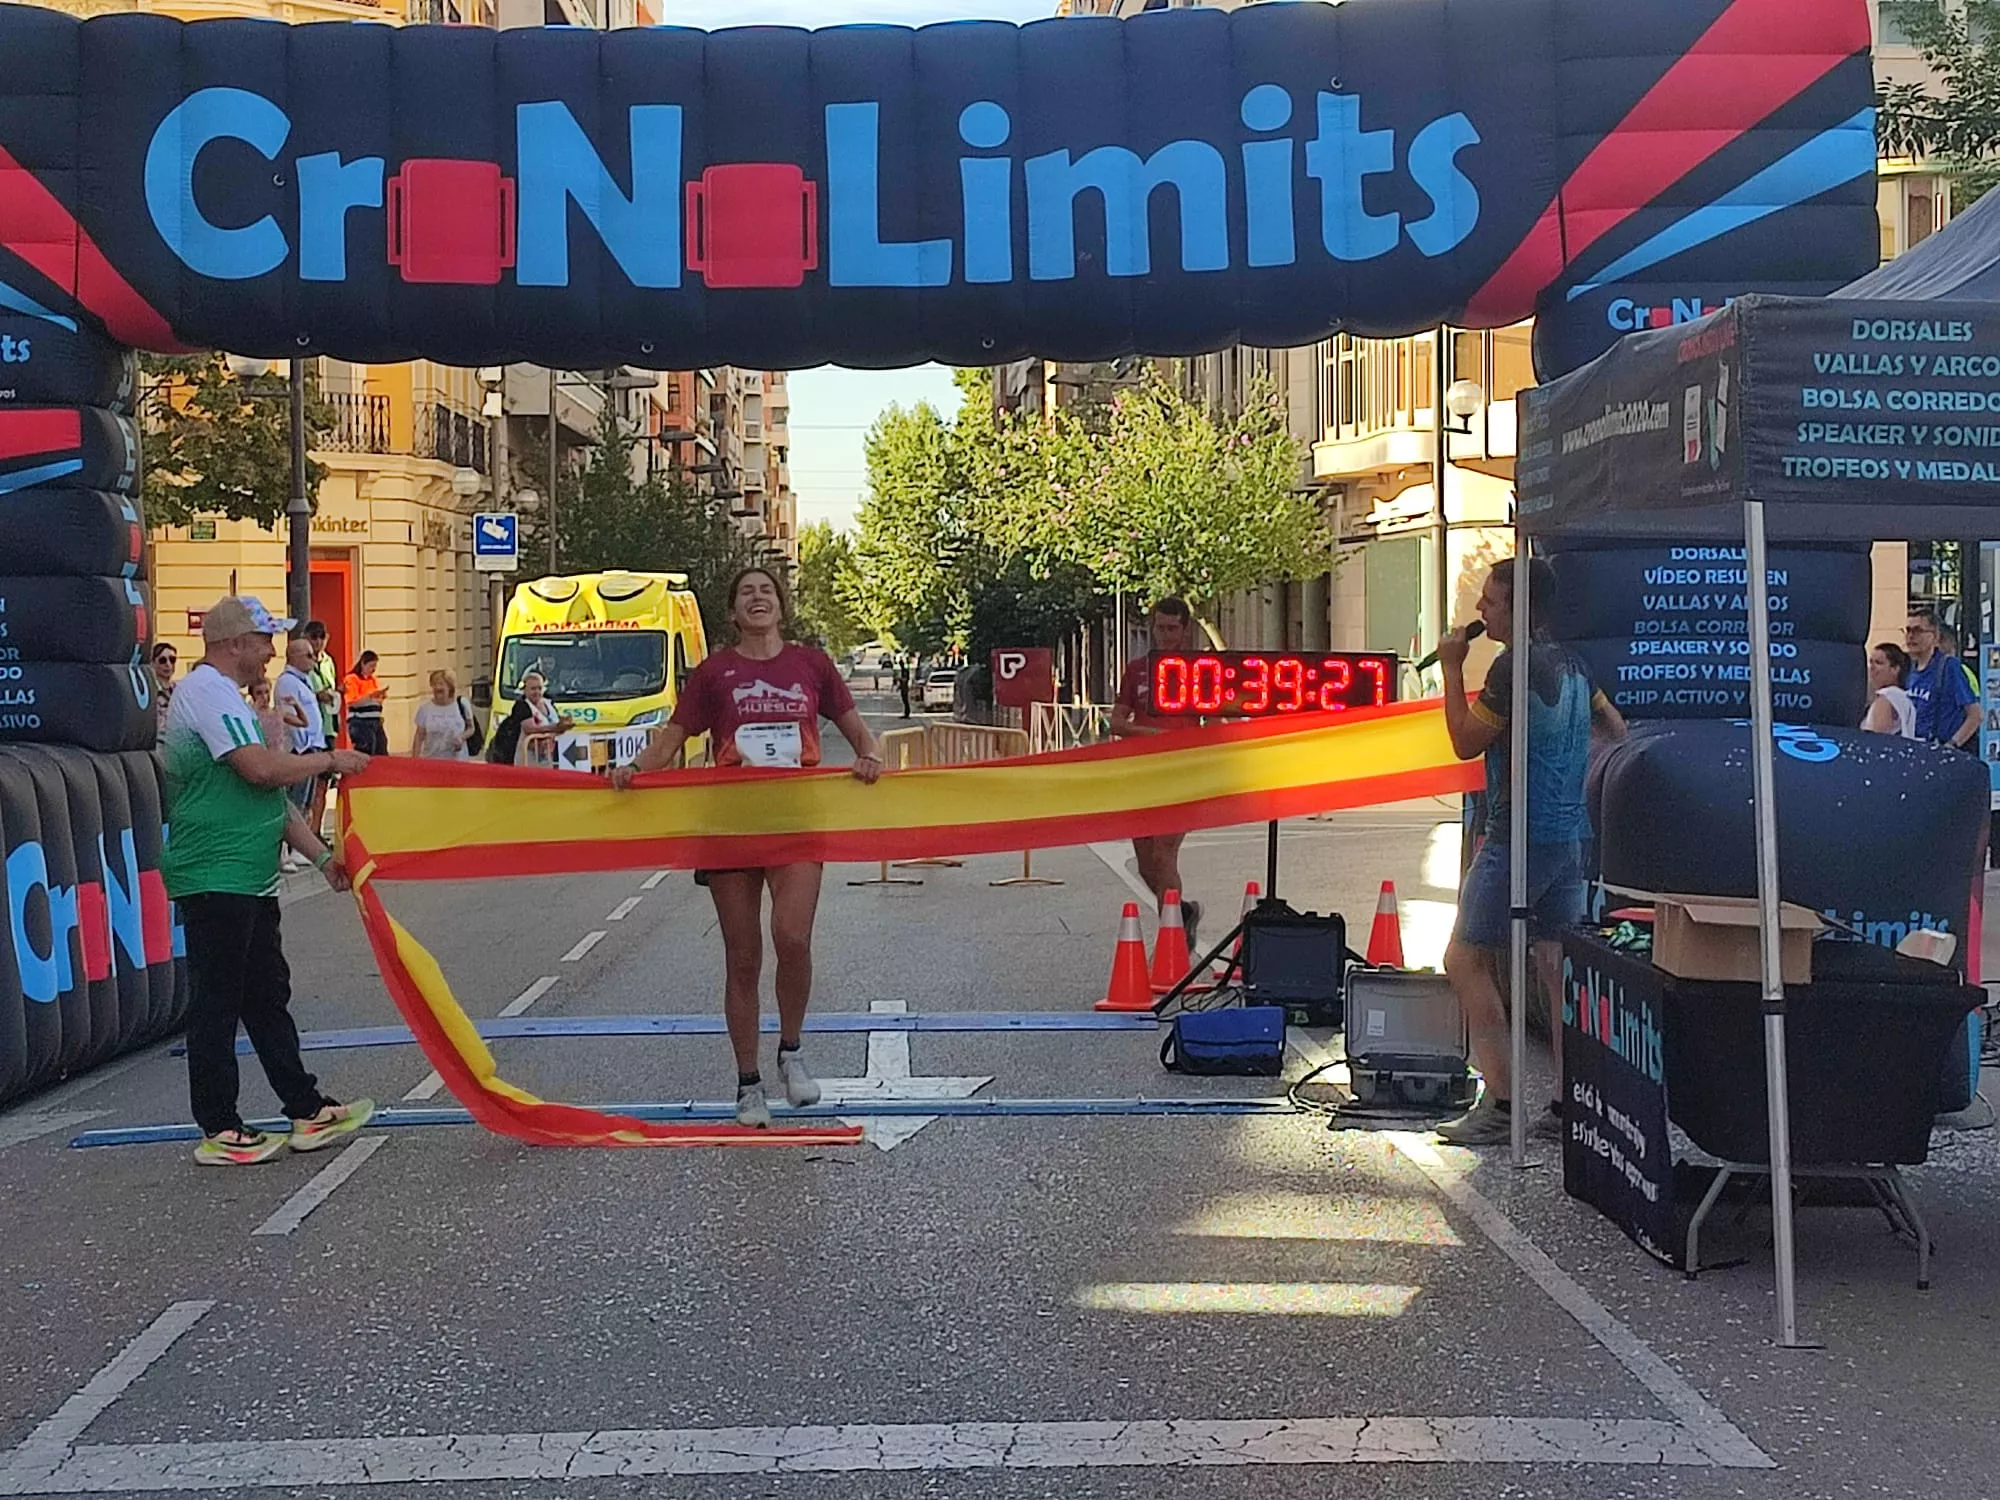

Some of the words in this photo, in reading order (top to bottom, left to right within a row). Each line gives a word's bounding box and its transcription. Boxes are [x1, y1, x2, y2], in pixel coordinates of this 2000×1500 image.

[1852, 319, 1973, 342] DORSALES
[1813, 353, 1904, 376] VALLAS
[1909, 355, 1927, 376] Y
[1931, 356, 2000, 377] ARCO
[1803, 388, 1882, 410] BOLSA
[1886, 390, 2000, 412] CORREDO
[1798, 422, 1905, 445] SPEAKER
[1911, 425, 1928, 445] Y
[1782, 456, 1890, 479] TROFEOS
[1894, 459, 1911, 480] Y
[1917, 460, 2000, 482] MEDAL
[1671, 547, 1748, 561] DORSAL
[1644, 566, 1701, 585] VÍDEO
[1705, 569, 1788, 586] RESUEN
[1643, 594, 1710, 610] VALLAS
[1714, 594, 1727, 610] Y
[1729, 593, 1789, 612] AOS
[1634, 620, 1690, 634] BOLSA
[1695, 620, 1795, 636] CORROR
[1629, 640, 1709, 656] SPEAKER
[1713, 641, 1726, 656] Y
[1729, 641, 1798, 658] SODO
[1157, 657, 1385, 711] 00:39:27
[1617, 664, 1697, 682] TROFEOS
[1701, 665, 1715, 681] Y
[1718, 665, 1811, 684] MELLAS
[1615, 690, 1658, 706] CHIP
[1662, 690, 1729, 705] ACTIVO
[1733, 690, 1745, 705] Y
[737, 702, 808, 716] HUESCA
[764, 743, 777, 756] 5
